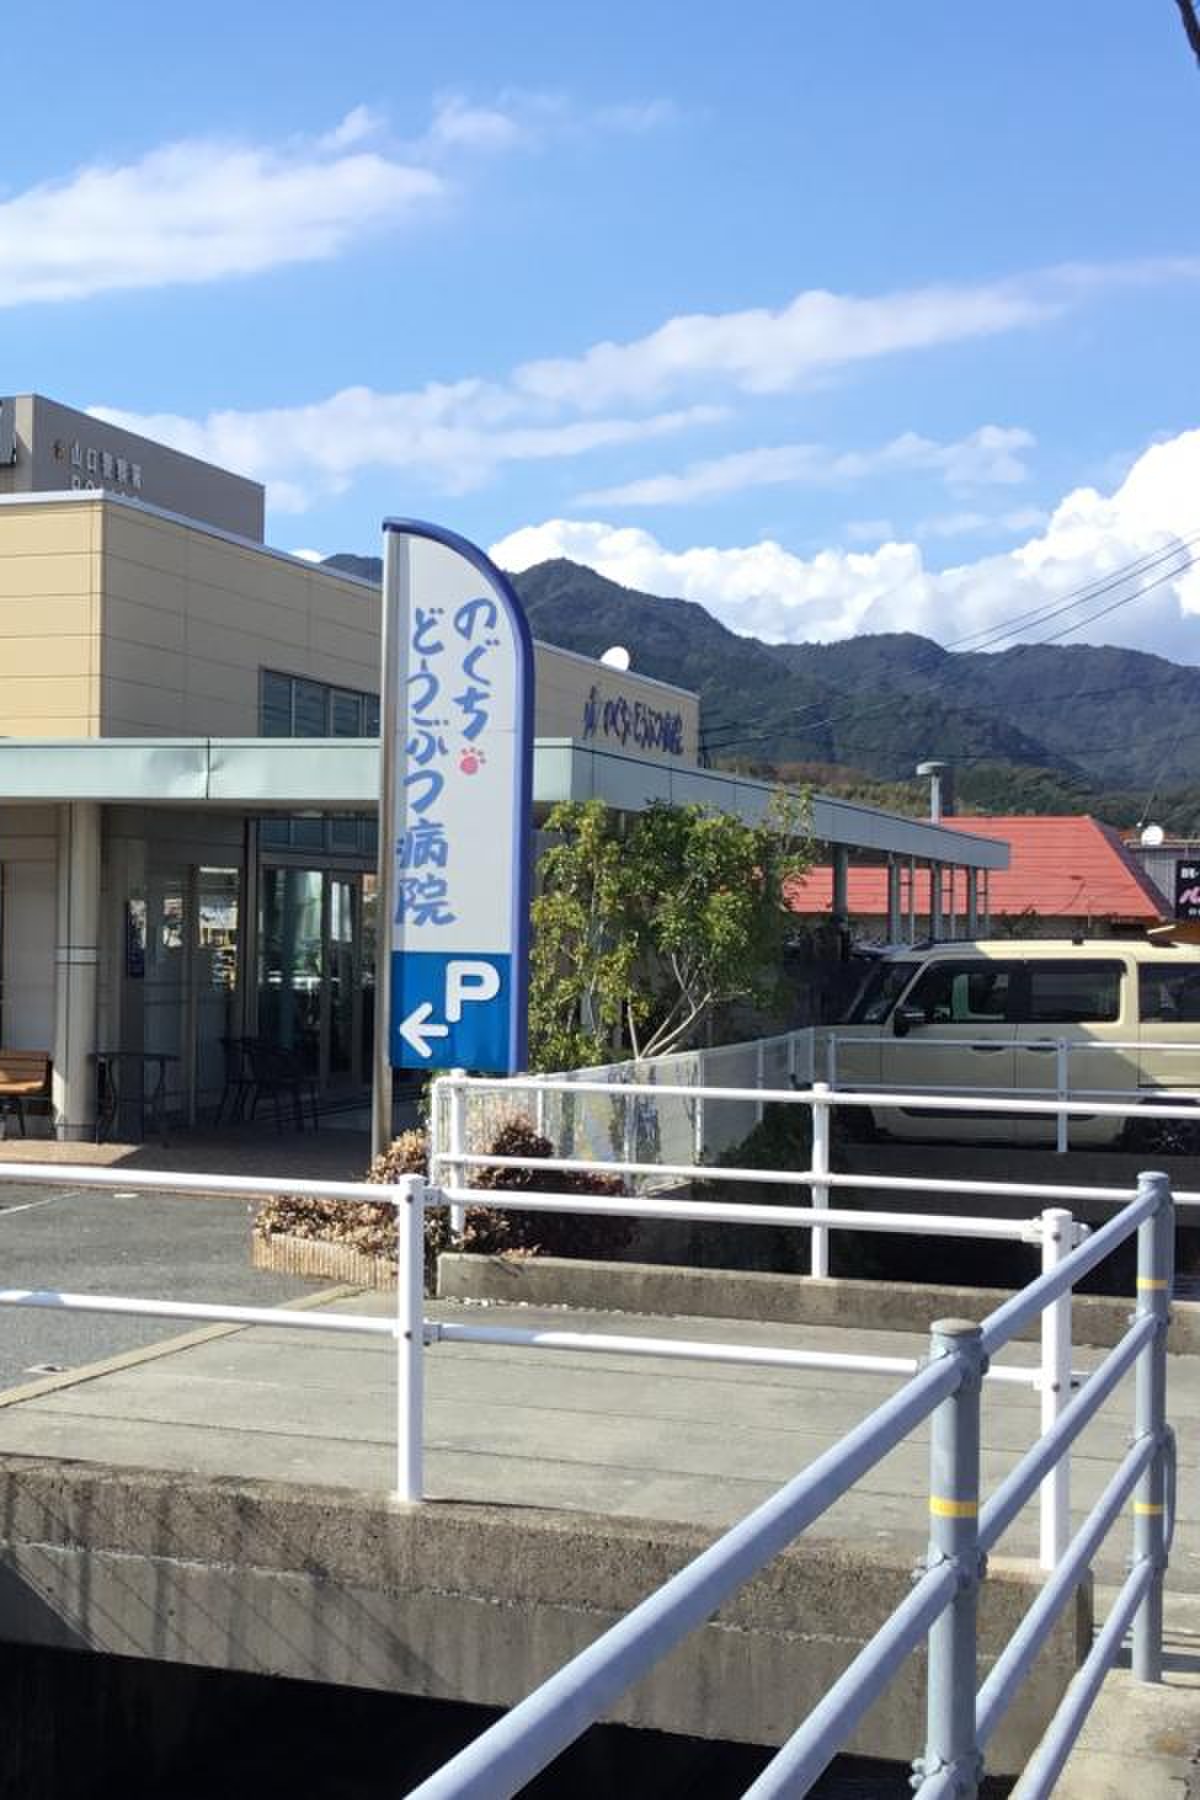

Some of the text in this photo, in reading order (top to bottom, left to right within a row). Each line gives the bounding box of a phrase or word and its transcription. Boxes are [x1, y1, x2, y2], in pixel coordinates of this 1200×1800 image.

[453, 598, 499, 741] のぐち
[395, 607, 455, 926] どうぶつ病院
[445, 961, 500, 1023] P
